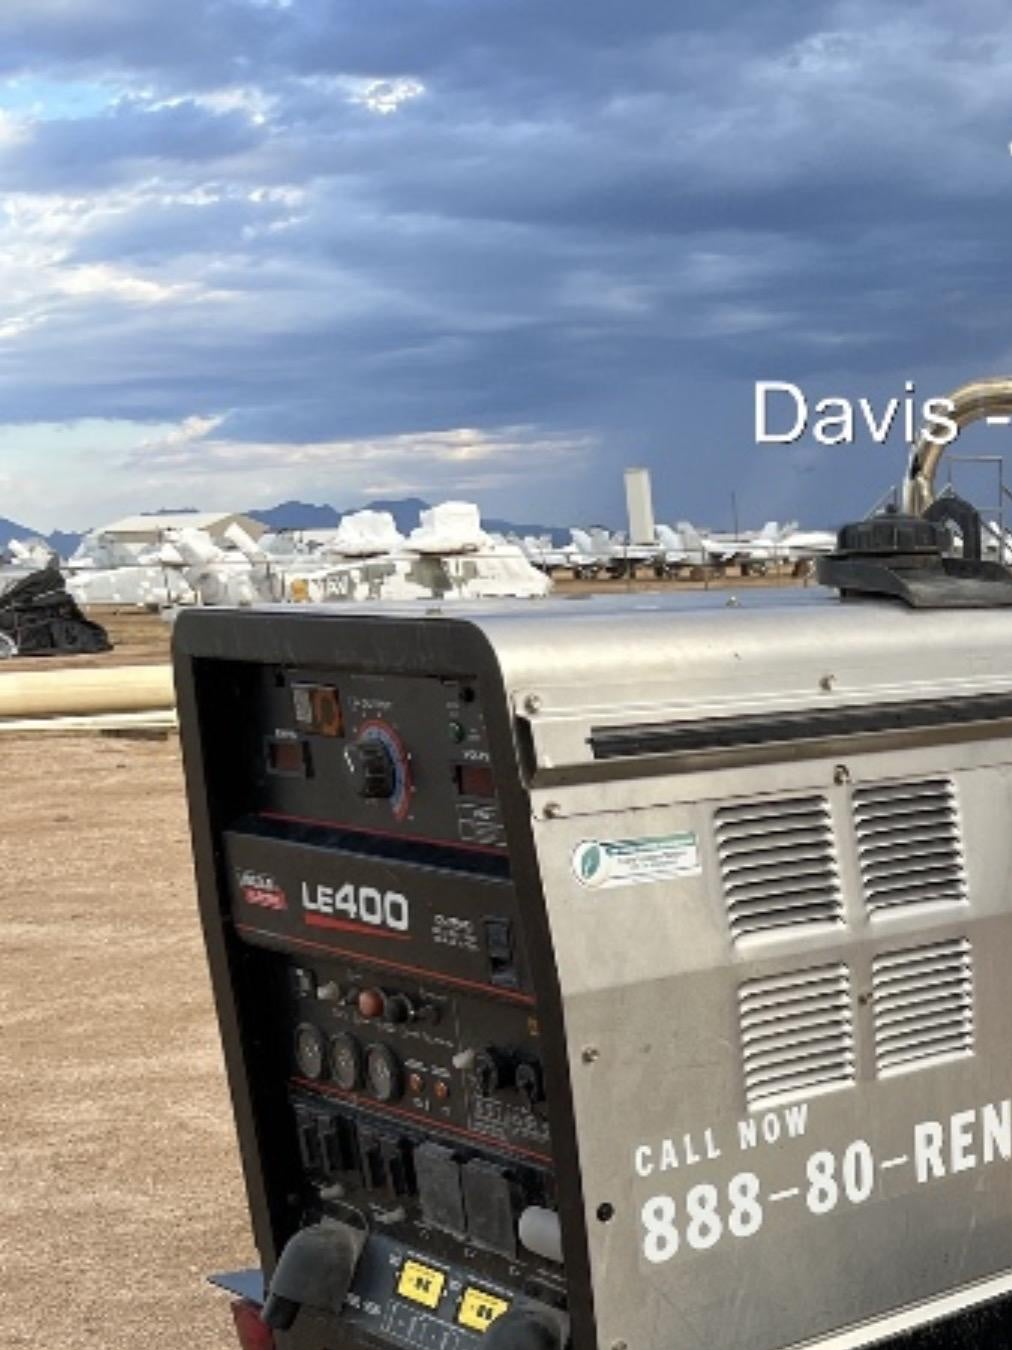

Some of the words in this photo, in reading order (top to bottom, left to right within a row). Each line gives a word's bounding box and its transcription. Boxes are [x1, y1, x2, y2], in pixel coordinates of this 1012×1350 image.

[301, 881, 409, 931] LE400
[635, 1128, 722, 1176] CALL
[737, 1104, 809, 1150] NOW
